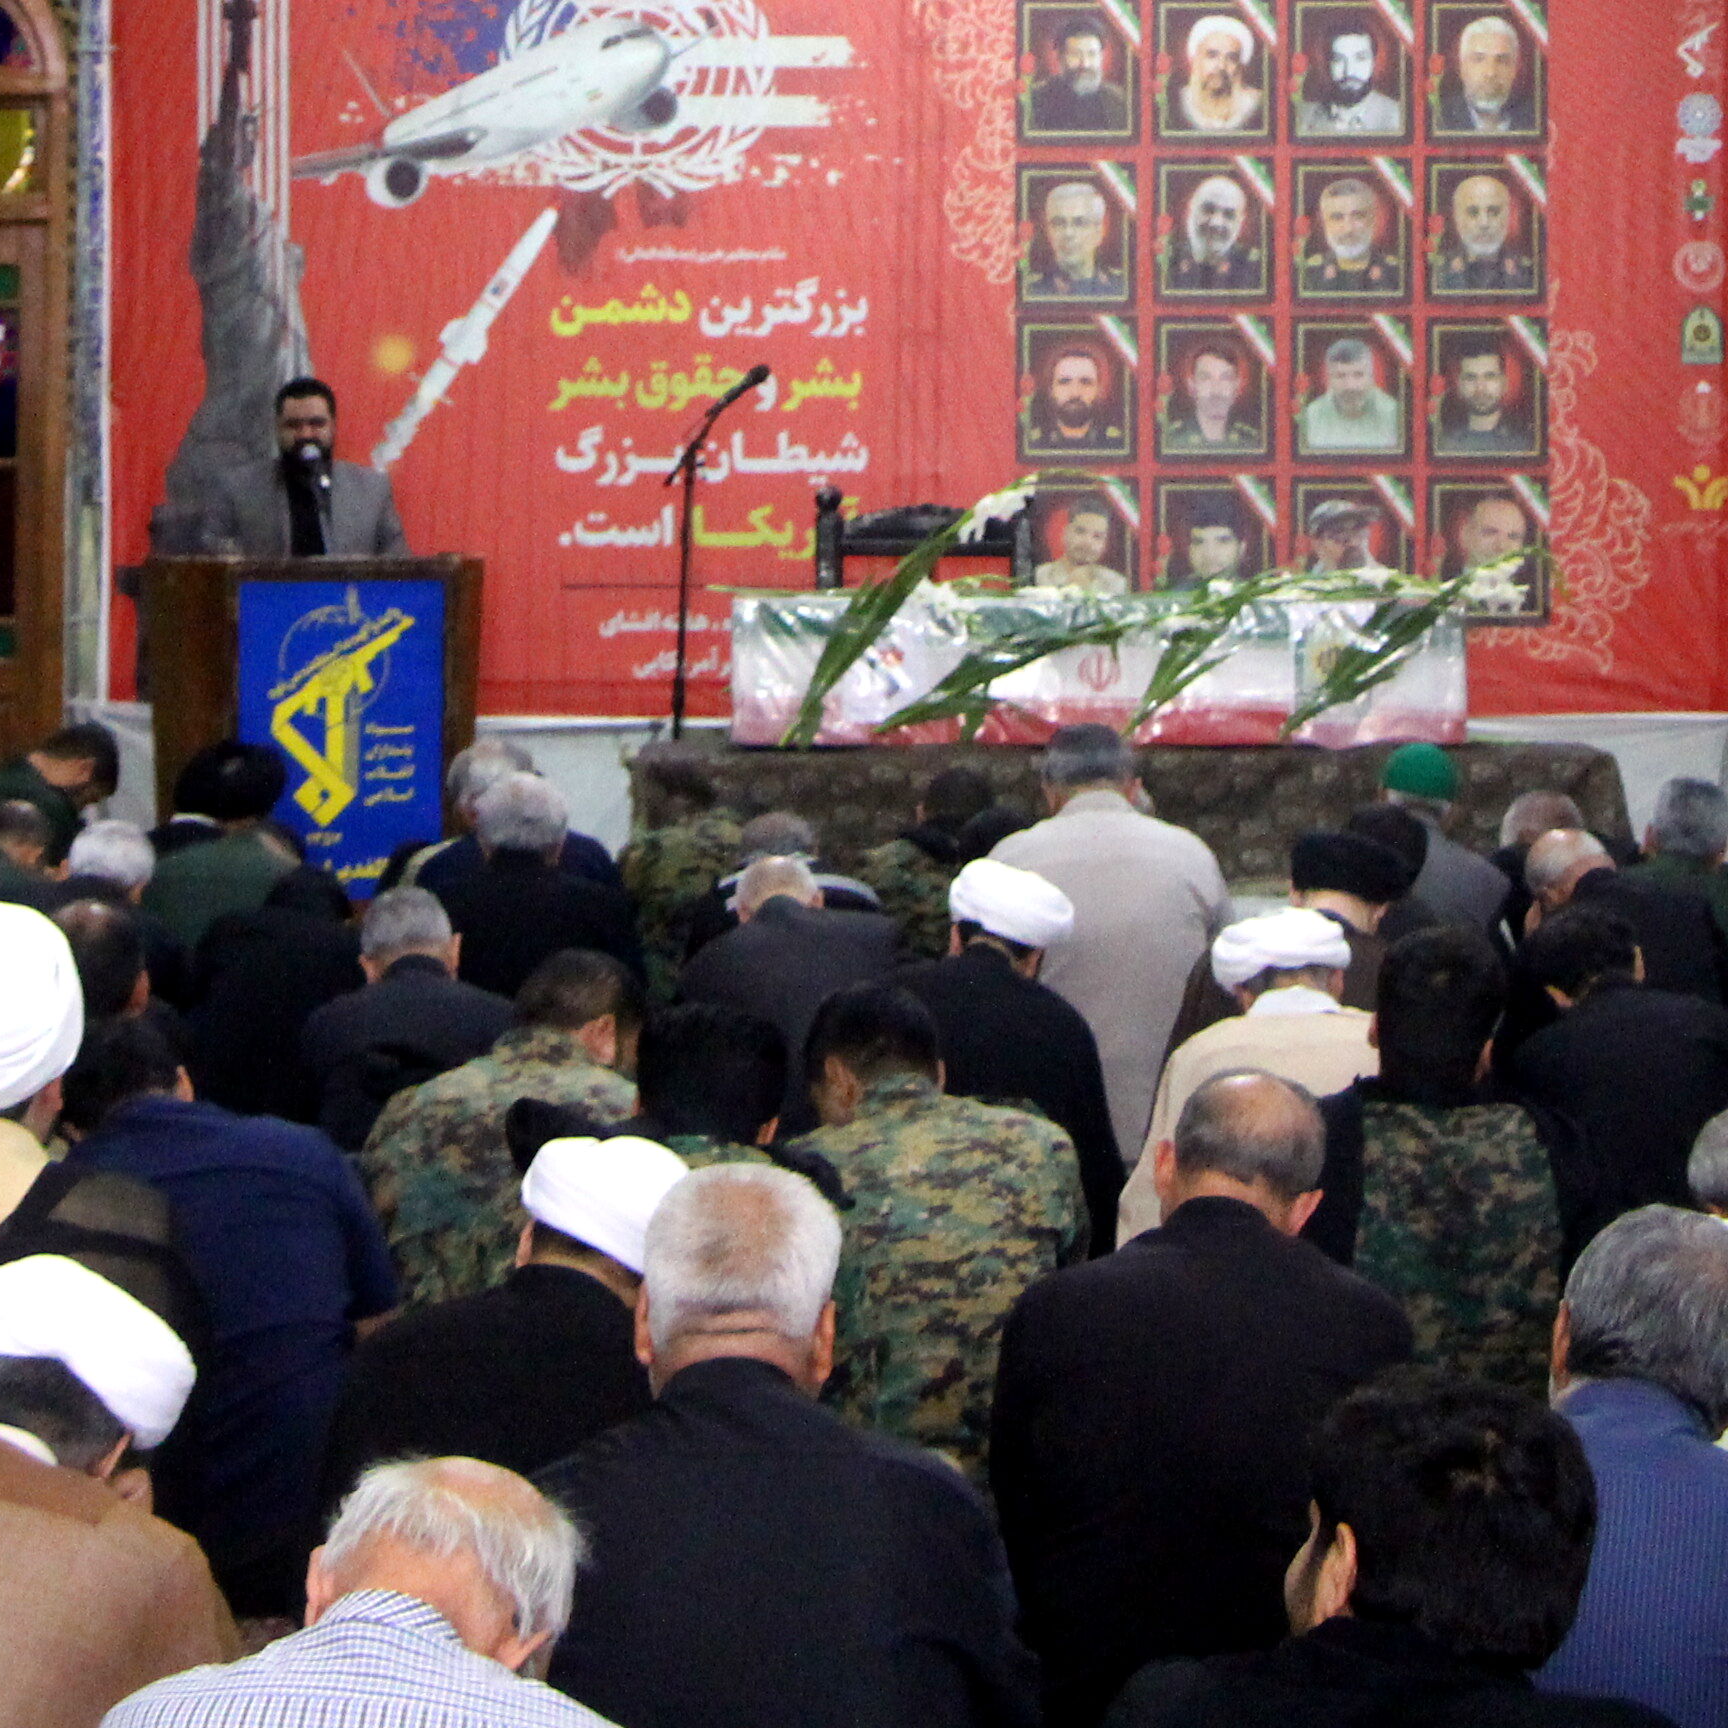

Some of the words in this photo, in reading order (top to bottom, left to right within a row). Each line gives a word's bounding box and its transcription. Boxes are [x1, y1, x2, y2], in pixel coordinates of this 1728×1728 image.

[549, 283, 693, 338] دشمن
[698, 276, 870, 338] بزرگترین
[548, 356, 631, 412] بشر
[634, 353, 750, 412] حقوق
[754, 371, 779, 412] و
[780, 357, 863, 413] بشر
[554, 425, 685, 486] بزرگ
[695, 429, 870, 485] شیطان
